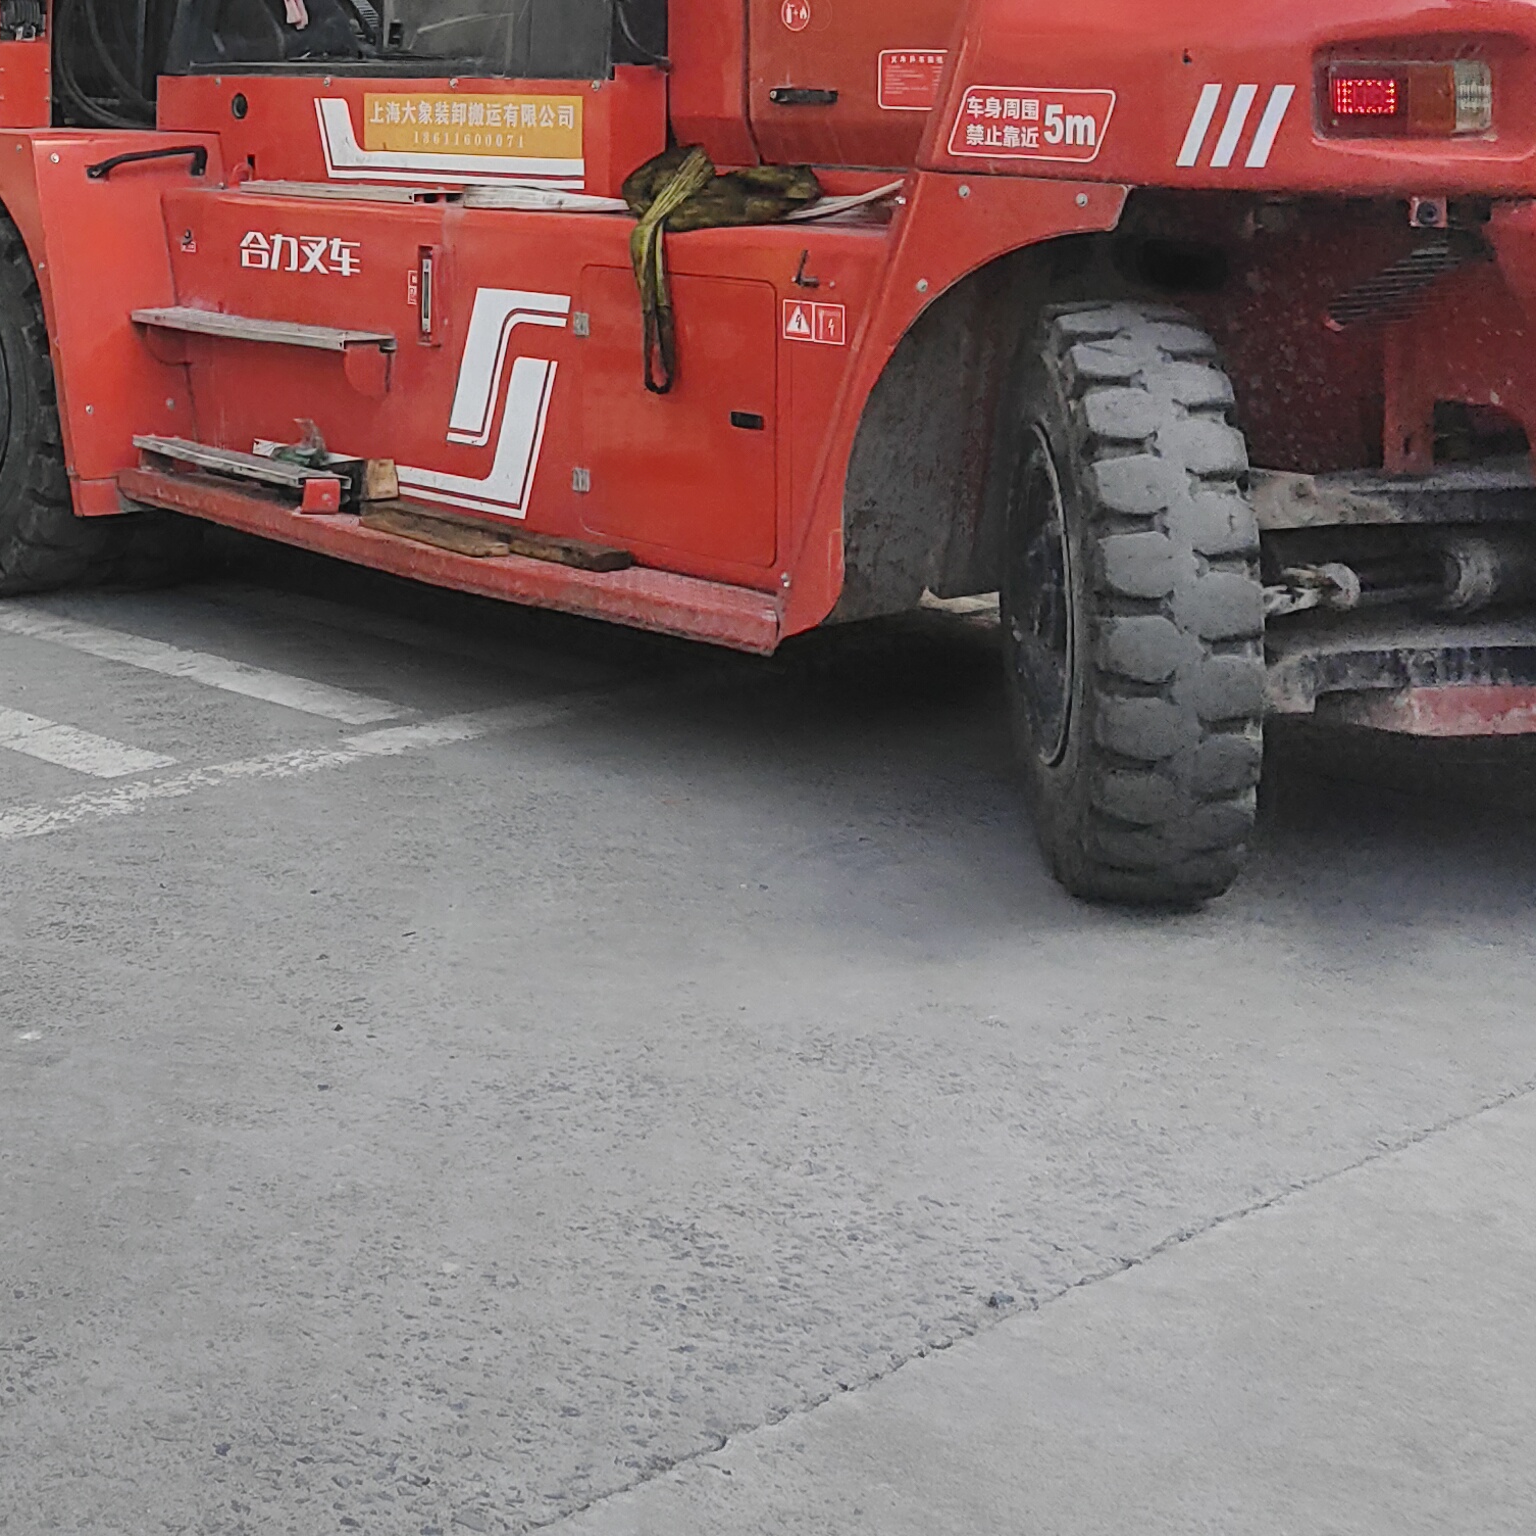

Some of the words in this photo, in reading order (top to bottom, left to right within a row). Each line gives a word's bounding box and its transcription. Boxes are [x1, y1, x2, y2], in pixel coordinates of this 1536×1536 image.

[369, 99, 575, 129] 上海大象装卸搬运有限公司
[966, 96, 1040, 121] 车身周围
[966, 123, 1040, 149] 禁止靠近
[1043, 103, 1096, 146] 5m
[239, 230, 361, 276] 合力叉车
